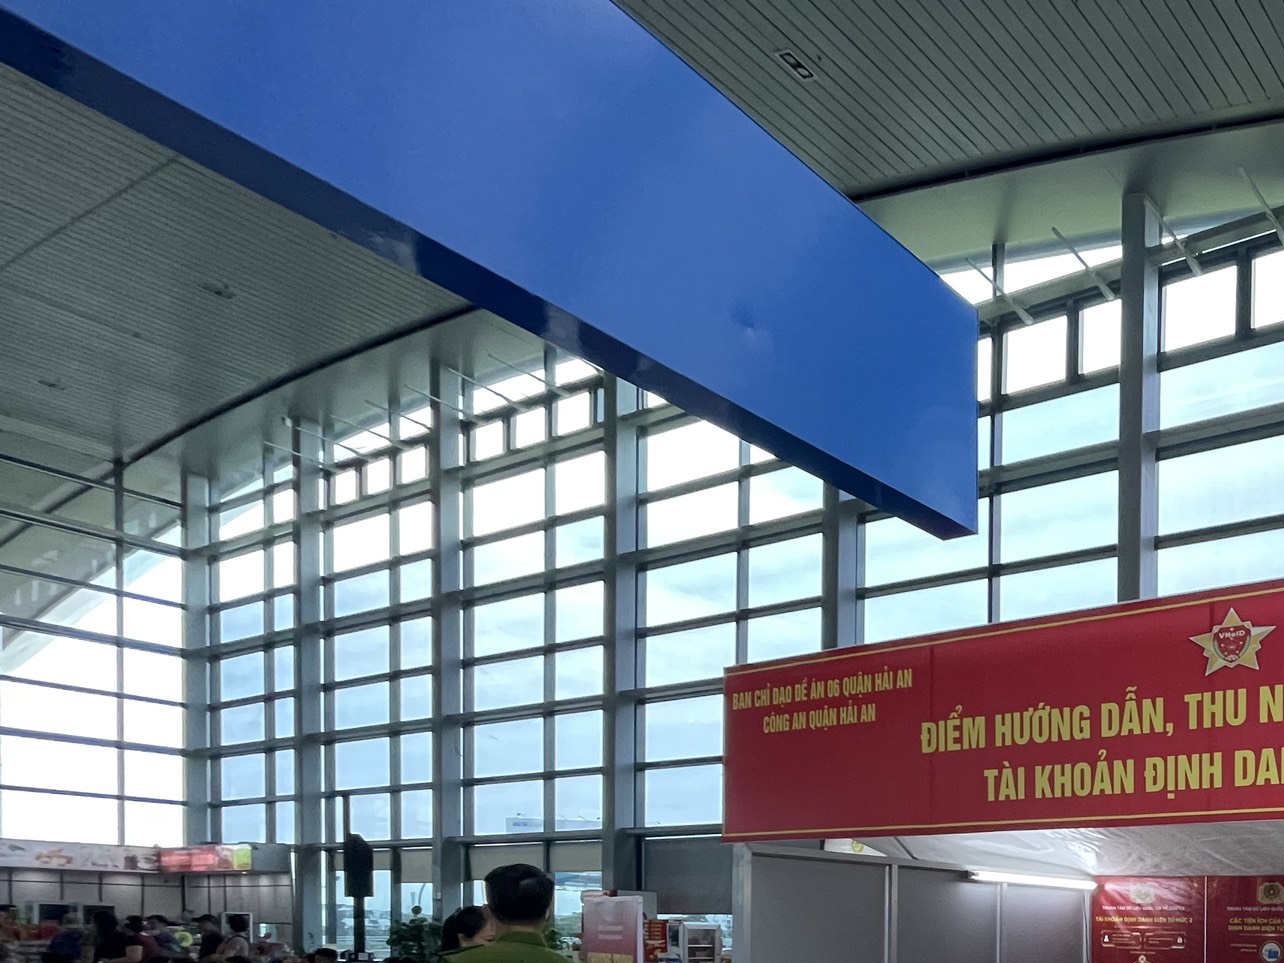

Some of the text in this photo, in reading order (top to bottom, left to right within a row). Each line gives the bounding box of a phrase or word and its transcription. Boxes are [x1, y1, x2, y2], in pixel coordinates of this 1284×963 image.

[1218, 629, 1246, 640] VNeID
[732, 690, 752, 711] BAN
[754, 682, 771, 707] CHỈ
[810, 678, 825, 700] ÁN
[827, 680, 840, 698] 06
[843, 671, 872, 698] QUẬN
[874, 665, 893, 691] HẢI
[896, 668, 912, 689] AN
[763, 699, 876, 734] CÔNG AN QUẬN HẢI AN
[920, 705, 986, 754] ĐIỂM
[995, 702, 1091, 747] HƯỚNG
[1100, 686, 1174, 738] DẪN,
[1184, 688, 1247, 730] THU
[983, 761, 1025, 802] TÀI
[1034, 749, 1135, 800] KHOẢN
[1143, 751, 1223, 800] ĐỊNH
